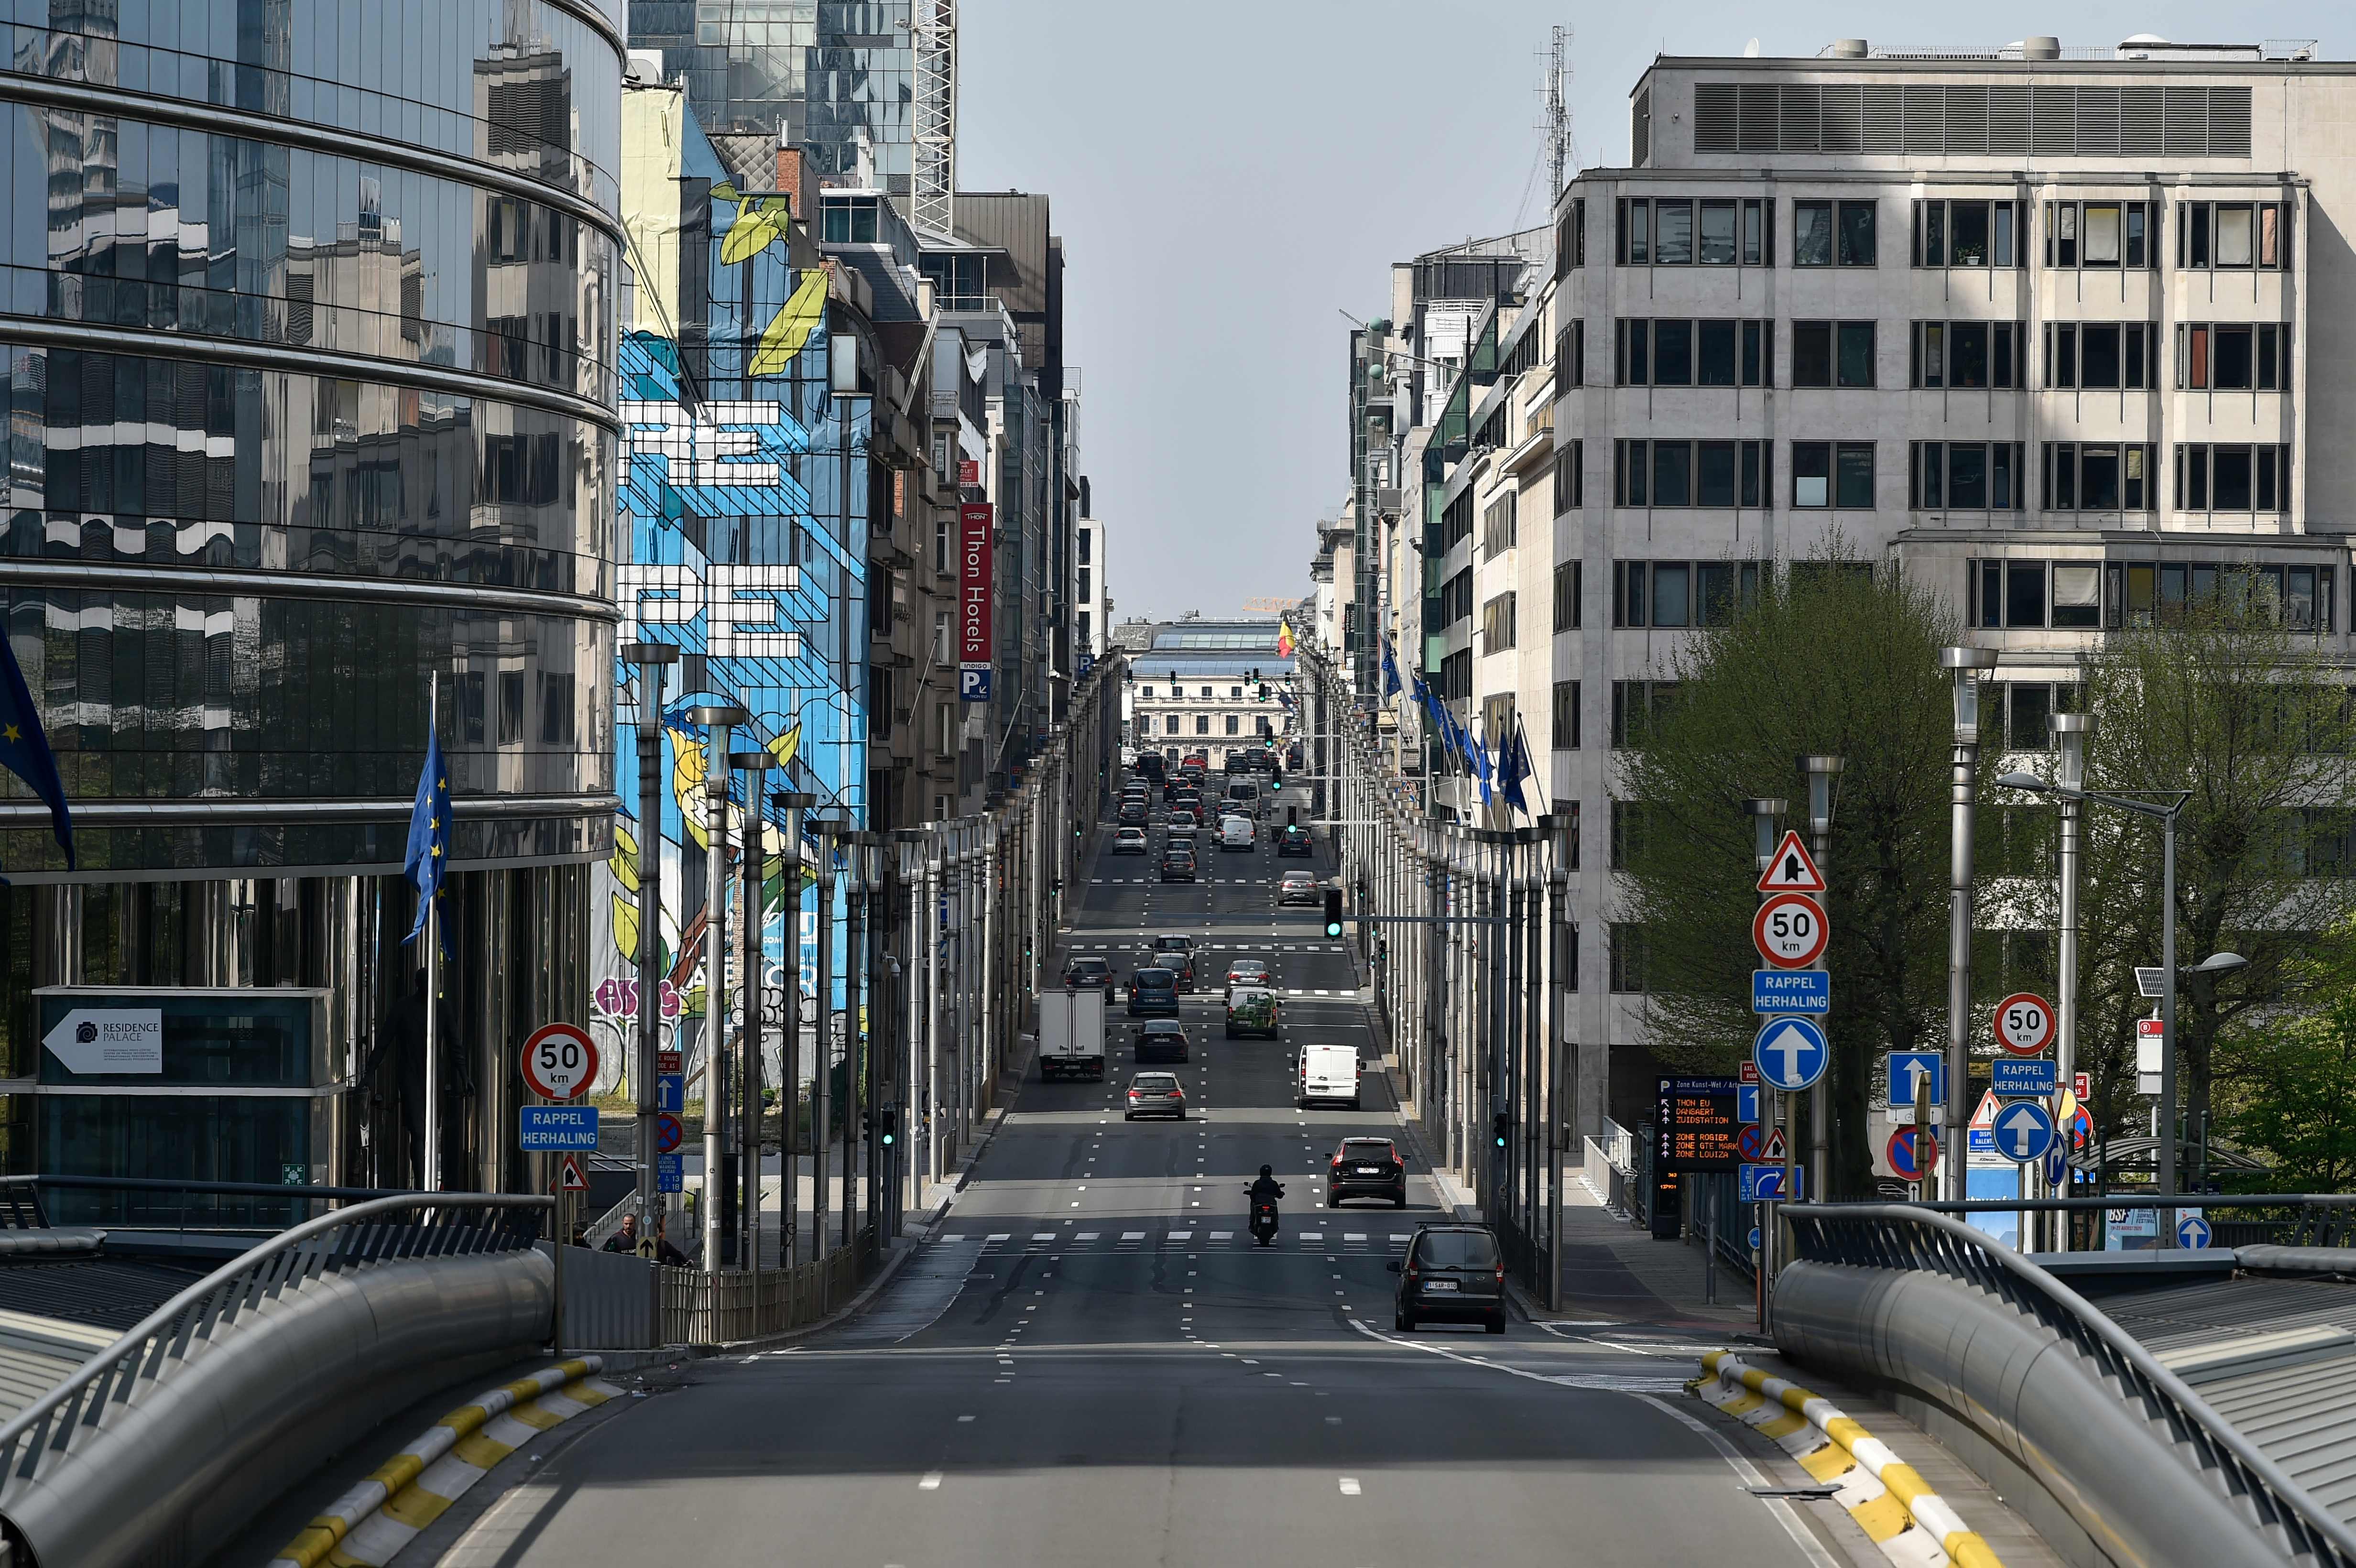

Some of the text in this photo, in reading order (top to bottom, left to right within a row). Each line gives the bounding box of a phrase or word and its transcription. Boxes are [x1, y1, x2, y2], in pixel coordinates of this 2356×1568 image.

[967, 526, 985, 652] Thon Hotels
[1080, 657, 1091, 670] P
[963, 672, 980, 694] P
[1773, 913, 1810, 937] 50
[1782, 941, 1800, 951] km
[1766, 977, 1816, 989] RAPPEL
[1756, 996, 1826, 1007] HERHALING
[2009, 1010, 2040, 1030] 50
[103, 1023, 159, 1032] RESIDENCE
[103, 1033, 142, 1041] PALACE
[2017, 1033, 2031, 1042] km
[541, 1044, 578, 1069] 50
[2003, 1066, 2044, 1075] RAPPEL
[550, 1073, 568, 1083] km
[1660, 1080, 1670, 1092] P
[1995, 1080, 2053, 1091] HERHALING
[533, 1113, 585, 1124] RAPPEL
[523, 1132, 596, 1144] HERHALING
